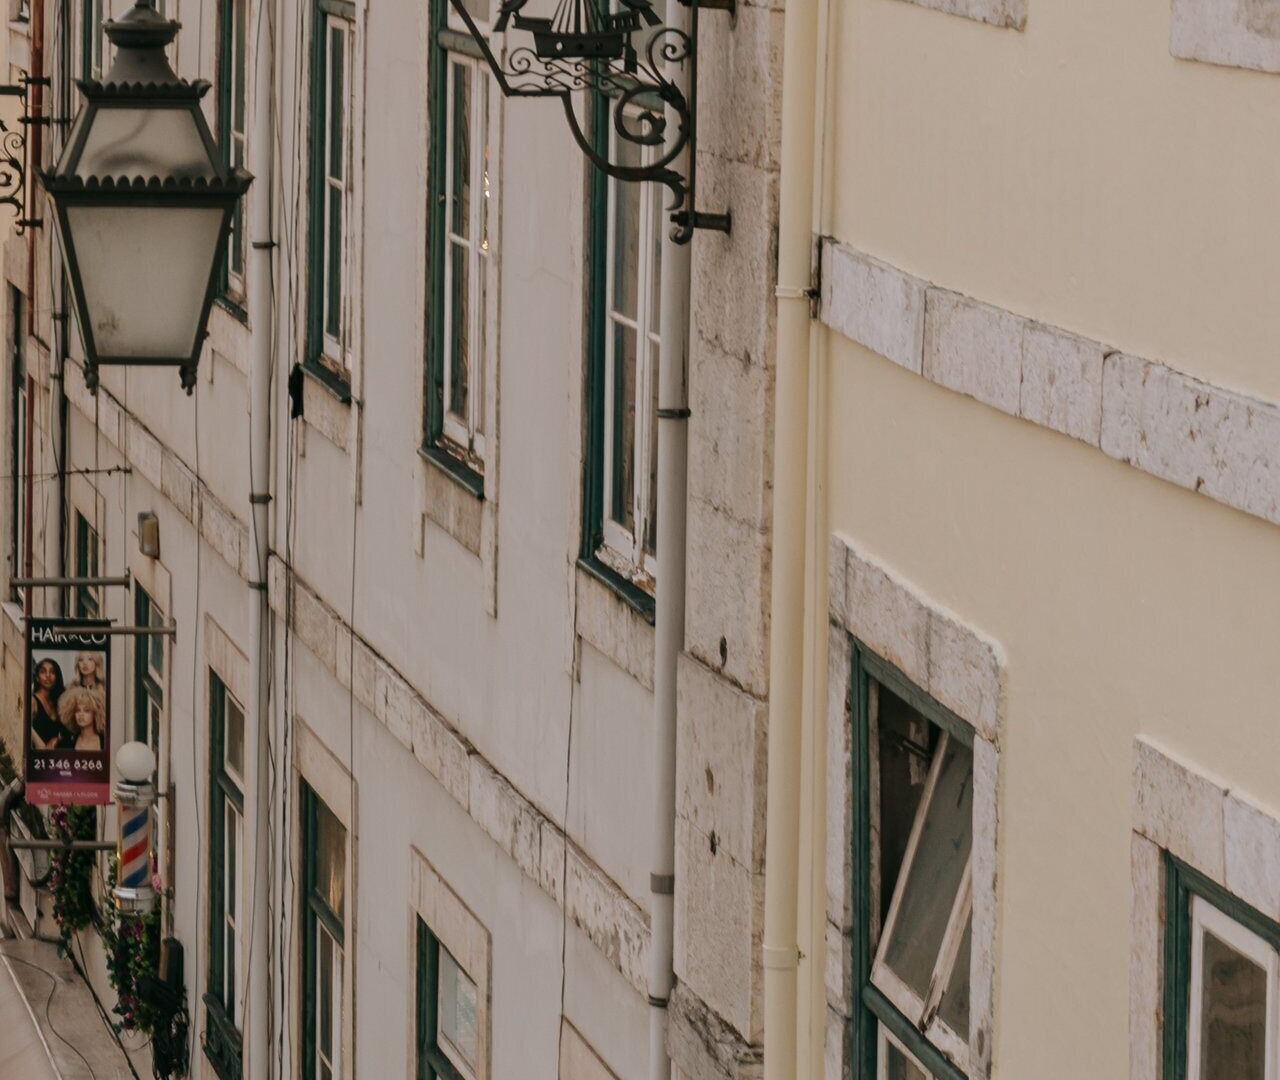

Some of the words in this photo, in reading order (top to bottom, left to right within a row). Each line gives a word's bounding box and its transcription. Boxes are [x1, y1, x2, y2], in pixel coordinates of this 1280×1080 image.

[34, 758, 46, 770] 21
[48, 758, 70, 770] 346
[73, 759, 103, 771] 8268
